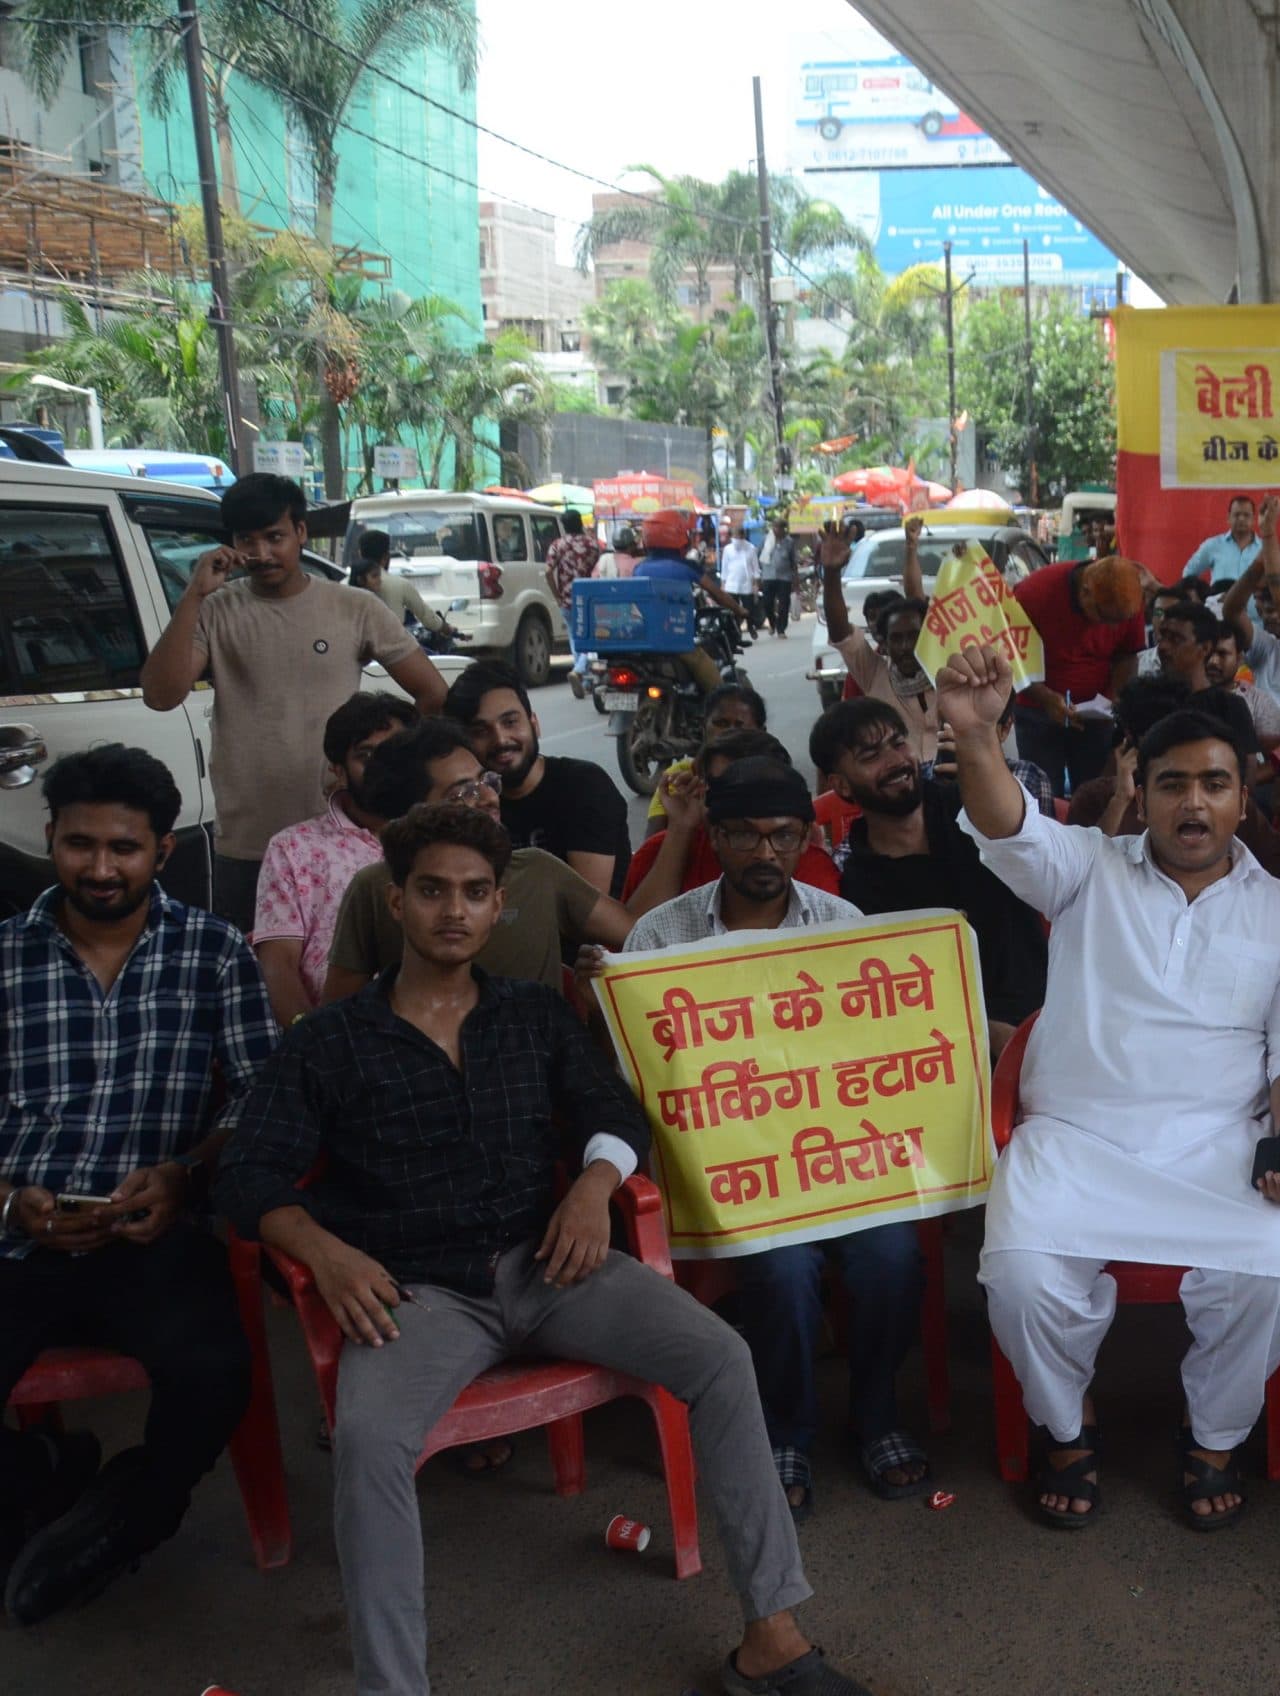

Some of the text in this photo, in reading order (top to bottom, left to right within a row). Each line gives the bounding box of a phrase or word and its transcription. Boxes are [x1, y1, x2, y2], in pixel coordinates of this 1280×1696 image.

[932, 203, 951, 219] All
[954, 203, 999, 219] Under
[1001, 203, 1032, 218] One
[1196, 364, 1274, 419] बेली
[1256, 434, 1279, 462] के
[646, 954, 935, 1061] ब्रीज के नीचे
[657, 1029, 956, 1133] पार्किंग हटाने
[705, 1119, 925, 1205] का विरोध
